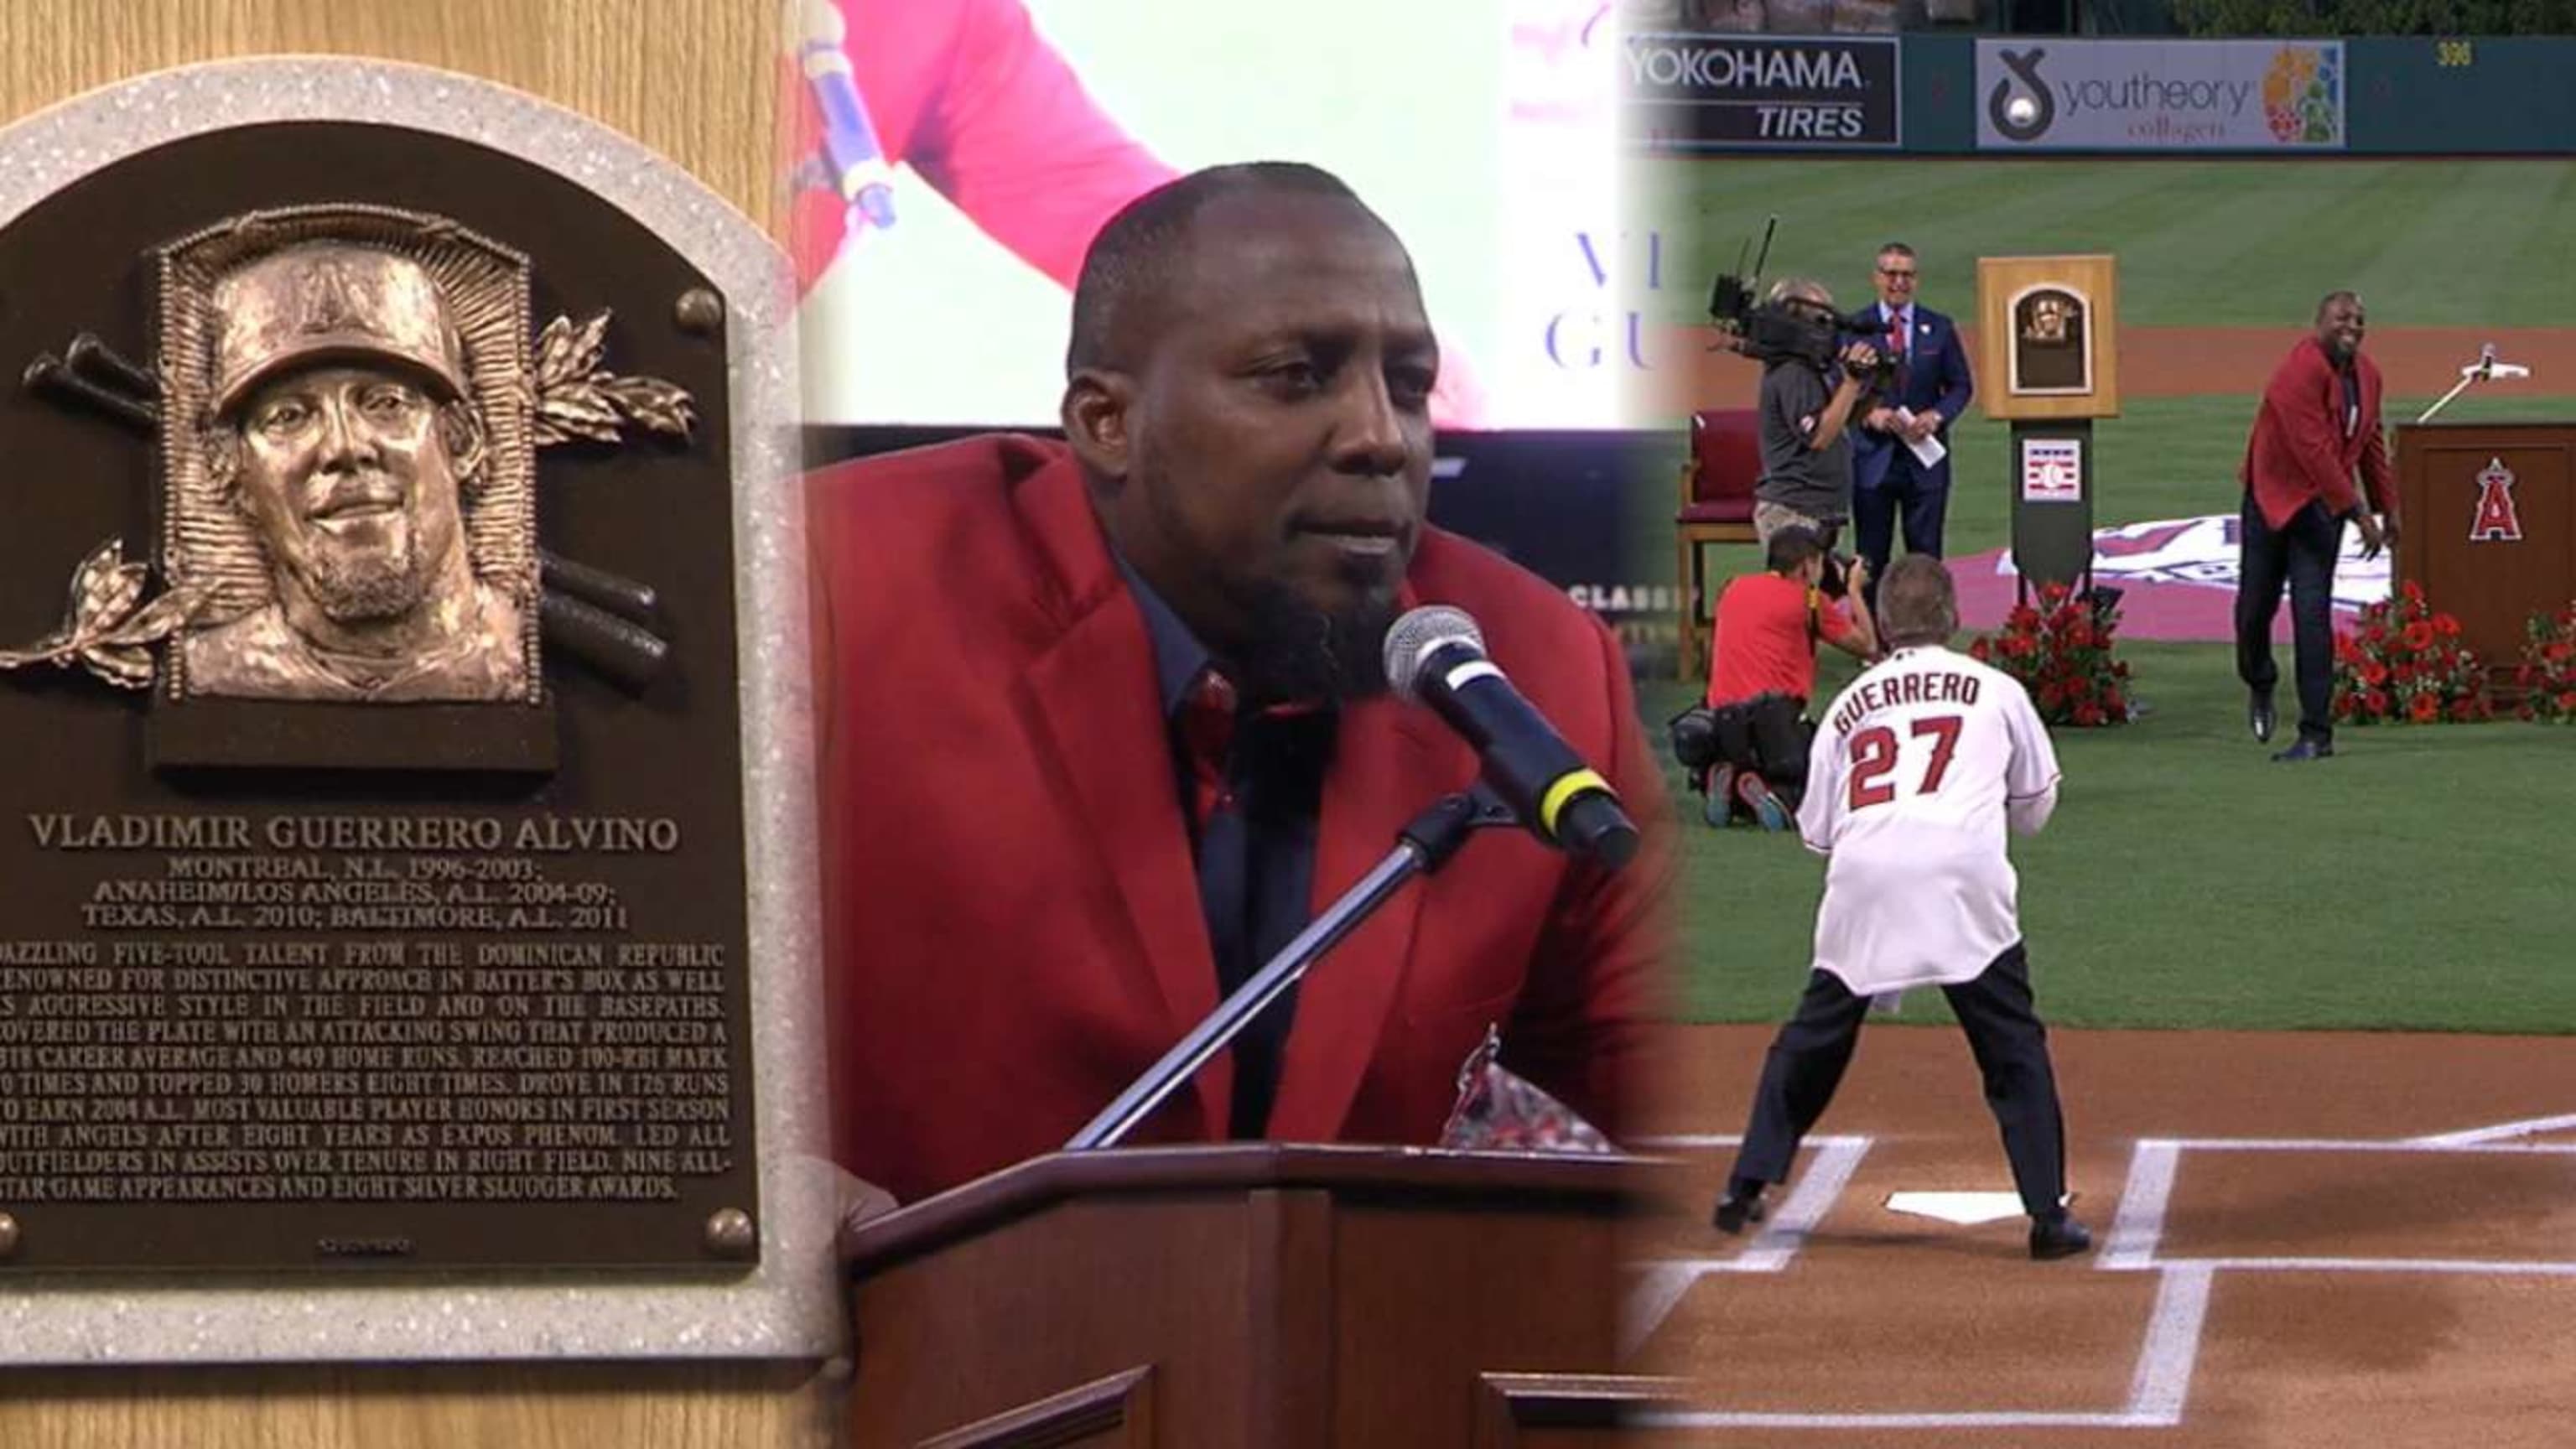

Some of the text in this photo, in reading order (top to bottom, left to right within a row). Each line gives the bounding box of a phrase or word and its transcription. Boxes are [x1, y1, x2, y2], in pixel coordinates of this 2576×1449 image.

[1626, 49, 1862, 88] YOKOHAMA
[2062, 71, 2249, 117] youtheory
[1757, 106, 1863, 138] TIRES
[2127, 116, 2225, 143] collagen
[1832, 672, 1981, 736] GUERRERO
[1848, 714, 1964, 813] 27
[29, 814, 679, 849] VLADIMIR GUERRERO ALVINO
[169, 856, 336, 882] MONTREAL,
[93, 881, 295, 905] ANAHEIM/LOS
[301, 882, 442, 906] ANGELES,
[81, 905, 185, 929] TEXAS,
[331, 906, 503, 930] BALTIMORE,
[569, 906, 629, 930] 2011
[113, 943, 231, 965] FIVE-TOOL
[245, 943, 329, 966] TALENT
[344, 943, 405, 966] FROM
[416, 943, 463, 966] THE
[477, 943, 604, 967] DOMINICAN
[616, 944, 725, 967] REPUBLIC
[0, 969, 725, 992] ENOWNED FOR DISTINCTIVE APPROACH IN BATTER'S BOX AS WELL
[27, 995, 166, 1016] AGGRESSIVE
[177, 995, 249, 1017] STYLE
[262, 995, 288, 1017] IN
[302, 995, 345, 1017] THE
[359, 995, 426, 1017] FIELD
[437, 995, 485, 1017] AND
[497, 995, 530, 1017] ON
[543, 996, 586, 1018] THE
[600, 996, 725, 1018] BASEPATHS.
[0, 1020, 728, 1043] OVERED THE PLATE WITH AN ATTACKING SWING THAT PRODUCED A
[38, 1046, 125, 1068] CAREER
[129, 1046, 229, 1068] AVERAGE
[234, 1046, 283, 1068] AND
[288, 1046, 325, 1068] 449
[331, 1046, 394, 1068] HOME
[471, 1046, 573, 1069] REACHED
[580, 1046, 660, 1069] 100-RBI
[665, 1046, 729, 1069] MARK
[21, 1072, 86, 1095] TIMES
[91, 1072, 139, 1095] AND
[145, 1072, 232, 1095] TOPPED
[239, 1072, 262, 1095] 30
[270, 1072, 360, 1095] HOMERS
[366, 1072, 435, 1095] EIGHT
[519, 1072, 592, 1095] DROVE
[599, 1072, 623, 1095] IN
[672, 1072, 730, 1095] RUNS
[25, 1098, 84, 1121] EARN
[91, 1098, 138, 1121] 2004
[143, 1098, 185, 1121] A.L.
[192, 1098, 252, 1121] MOST
[255, 1098, 364, 1121] VALUABLE
[369, 1098, 452, 1121] PLAYER
[458, 1098, 547, 1121] HONORS
[551, 1098, 575, 1121] IN
[581, 1098, 643, 1121] FIRST
[646, 1098, 730, 1121] SEASON
[60, 1124, 148, 1147] ANGELS
[158, 1124, 229, 1147] AFTER
[242, 1124, 311, 1147] EIGHT
[321, 1124, 392, 1147] YEARS
[402, 1124, 430, 1147] AS
[441, 1124, 512, 1147] EXPOS
[635, 1124, 678, 1147] LED
[688, 1124, 732, 1147] ALL
[151, 1150, 176, 1173] IN
[181, 1150, 268, 1173] ASSISTS
[274, 1150, 336, 1173] OVER
[341, 1150, 428, 1173] TENURE
[435, 1150, 460, 1173] IN
[467, 1150, 536, 1173] RIGHT
[621, 1150, 677, 1173] NINE
[681, 1150, 734, 1173] ALL-
[0, 1176, 45, 1199] TAR
[50, 1176, 116, 1199] GAME
[120, 1176, 276, 1199] APPEARANCES
[279, 1176, 327, 1199] AND
[332, 1176, 402, 1199] EIGHT
[403, 1176, 480, 1199] SILVER
[484, 1176, 585, 1199] SLUGGER
